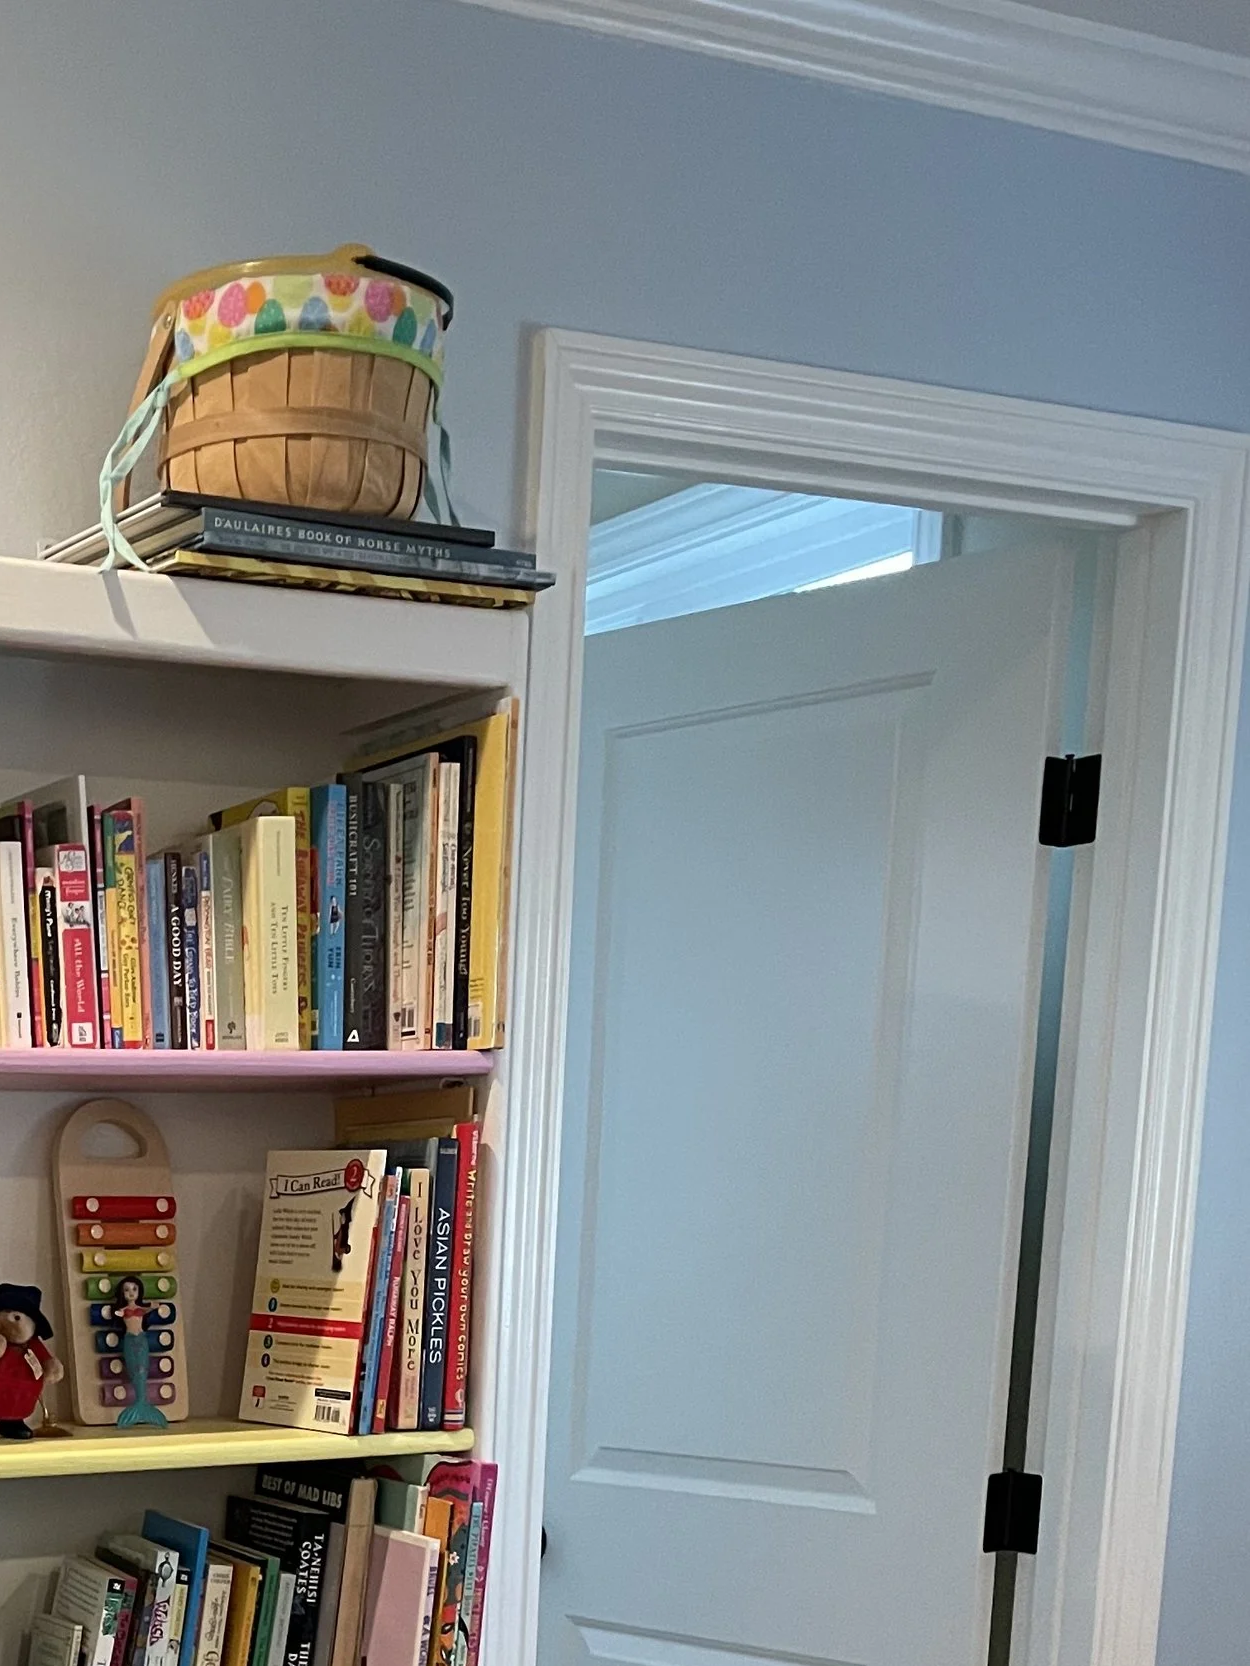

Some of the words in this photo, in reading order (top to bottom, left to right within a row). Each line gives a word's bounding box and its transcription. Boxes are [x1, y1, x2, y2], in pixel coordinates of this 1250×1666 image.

[298, 528, 332, 545] BOOK
[335, 534, 351, 547] OF
[358, 536, 401, 553] NORSE
[406, 543, 451, 559] MYTHS
[348, 794, 358, 875] BUSHCRAFT
[462, 844, 473, 888] Never
[222, 876, 233, 915] FAIRY
[349, 878, 357, 897] 101
[171, 904, 179, 912] A
[281, 906, 289, 923] TEN
[460, 895, 470, 921] Too
[73, 938, 83, 957] All
[171, 916, 181, 957] GOOD
[224, 922, 235, 965] BIBLE
[393, 915, 401, 949] Through
[74, 959, 83, 977] the
[173, 961, 182, 987] DAY
[327, 947, 335, 968] YUN
[76, 979, 85, 1013] World
[283, 1178, 288, 1192] I
[290, 1179, 311, 1192] Can
[312, 1175, 341, 1189] Read!
[417, 1181, 421, 1198] I
[466, 1169, 477, 1209] Write
[412, 1207, 422, 1261] Love
[434, 1207, 451, 1271] ASIAN
[461, 1232, 473, 1264] Draw
[388, 1276, 400, 1316] RUNAWAY
[409, 1268, 422, 1310] You
[457, 1269, 471, 1300] your
[386, 1318, 397, 1347] RALPH
[428, 1277, 447, 1364] PICKLES
[458, 1304, 468, 1331] own
[406, 1318, 420, 1371] More
[262, 1474, 283, 1491] BEST
[284, 1481, 296, 1495] OF
[298, 1484, 319, 1502] MAD
[322, 1490, 343, 1508] LIBS
[296, 1541, 312, 1594] COATES
[306, 1533, 325, 1603] TA-NEHISI
